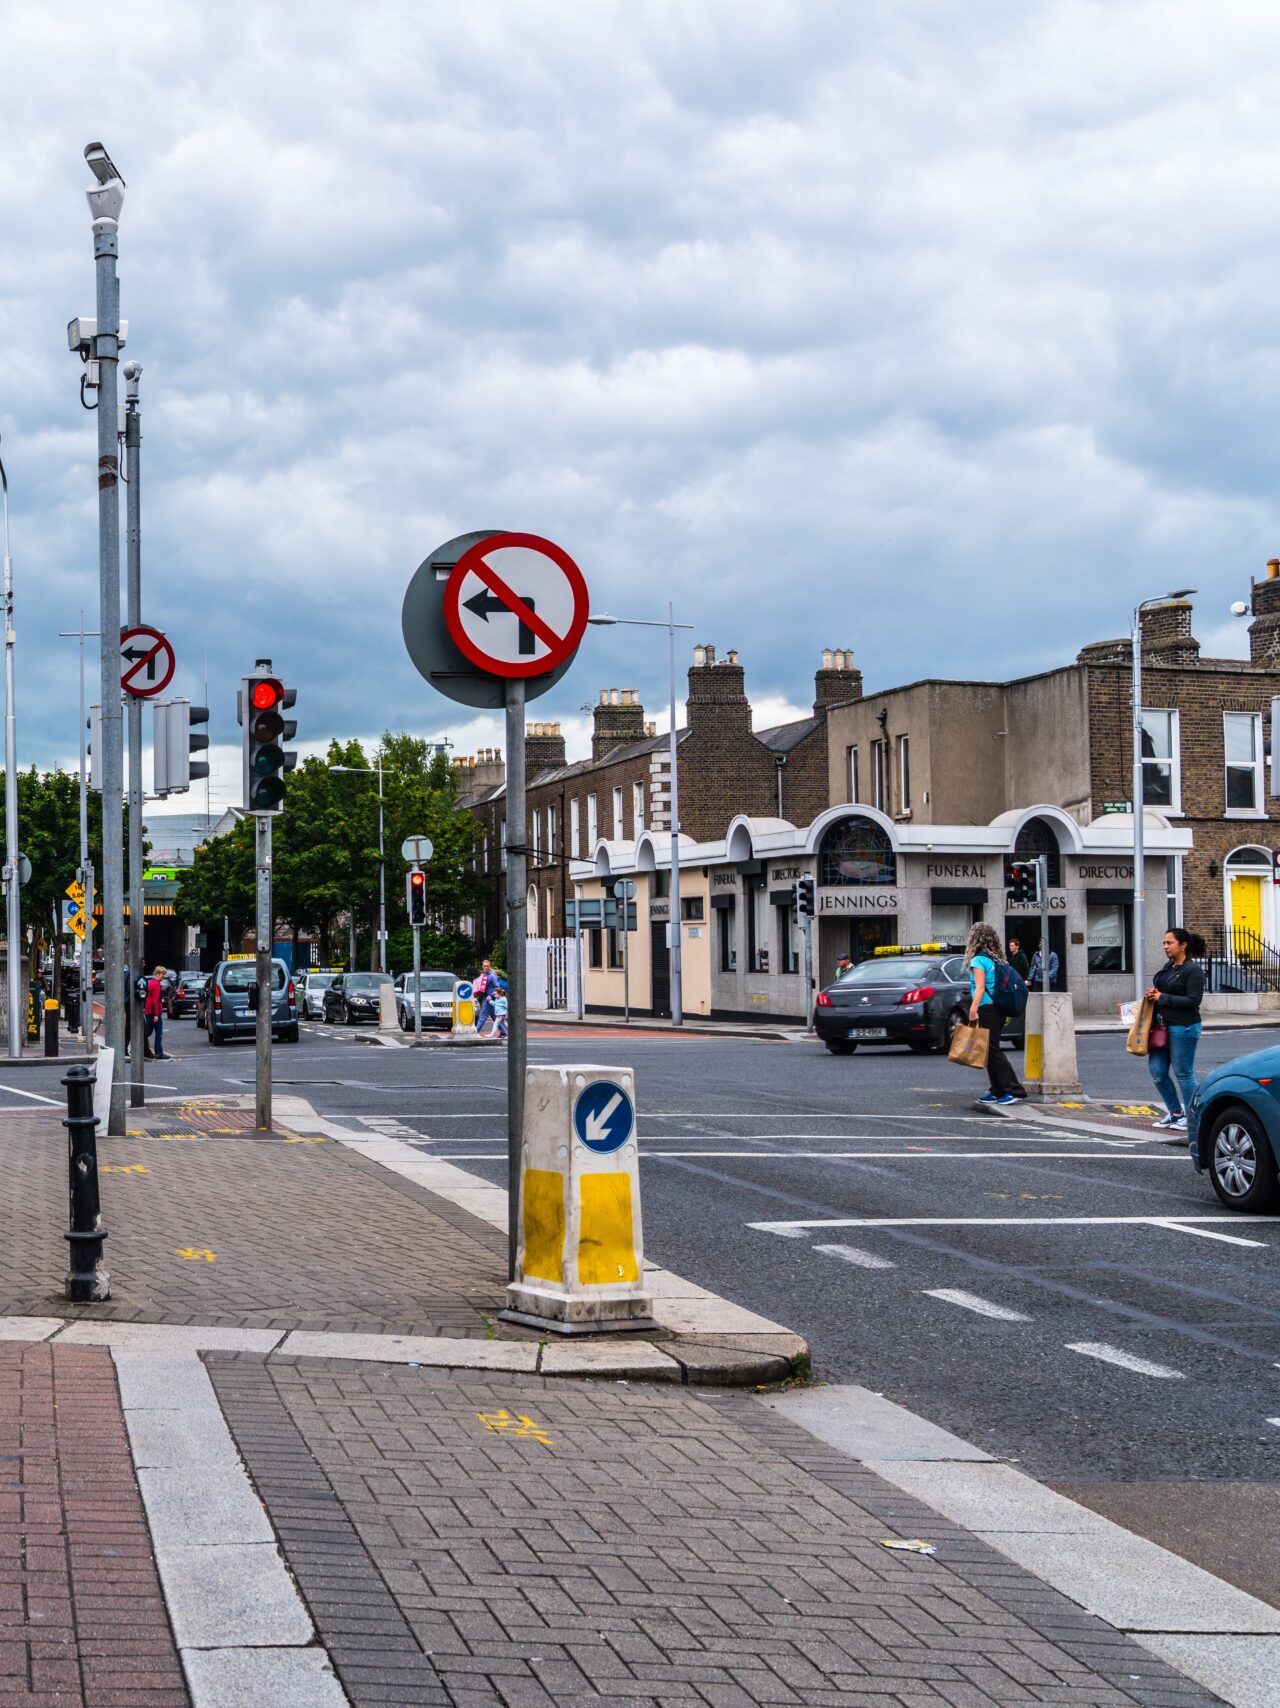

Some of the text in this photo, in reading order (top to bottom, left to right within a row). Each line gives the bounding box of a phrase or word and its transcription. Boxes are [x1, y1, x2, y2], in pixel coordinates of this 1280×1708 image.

[714, 867, 801, 885] FUNERAL DIRECTORS
[927, 865, 987, 877] FUNERAL
[819, 895, 898, 911] JENNINGS
[650, 905, 669, 918] JENNINGS
[932, 933, 965, 944] Jennings
